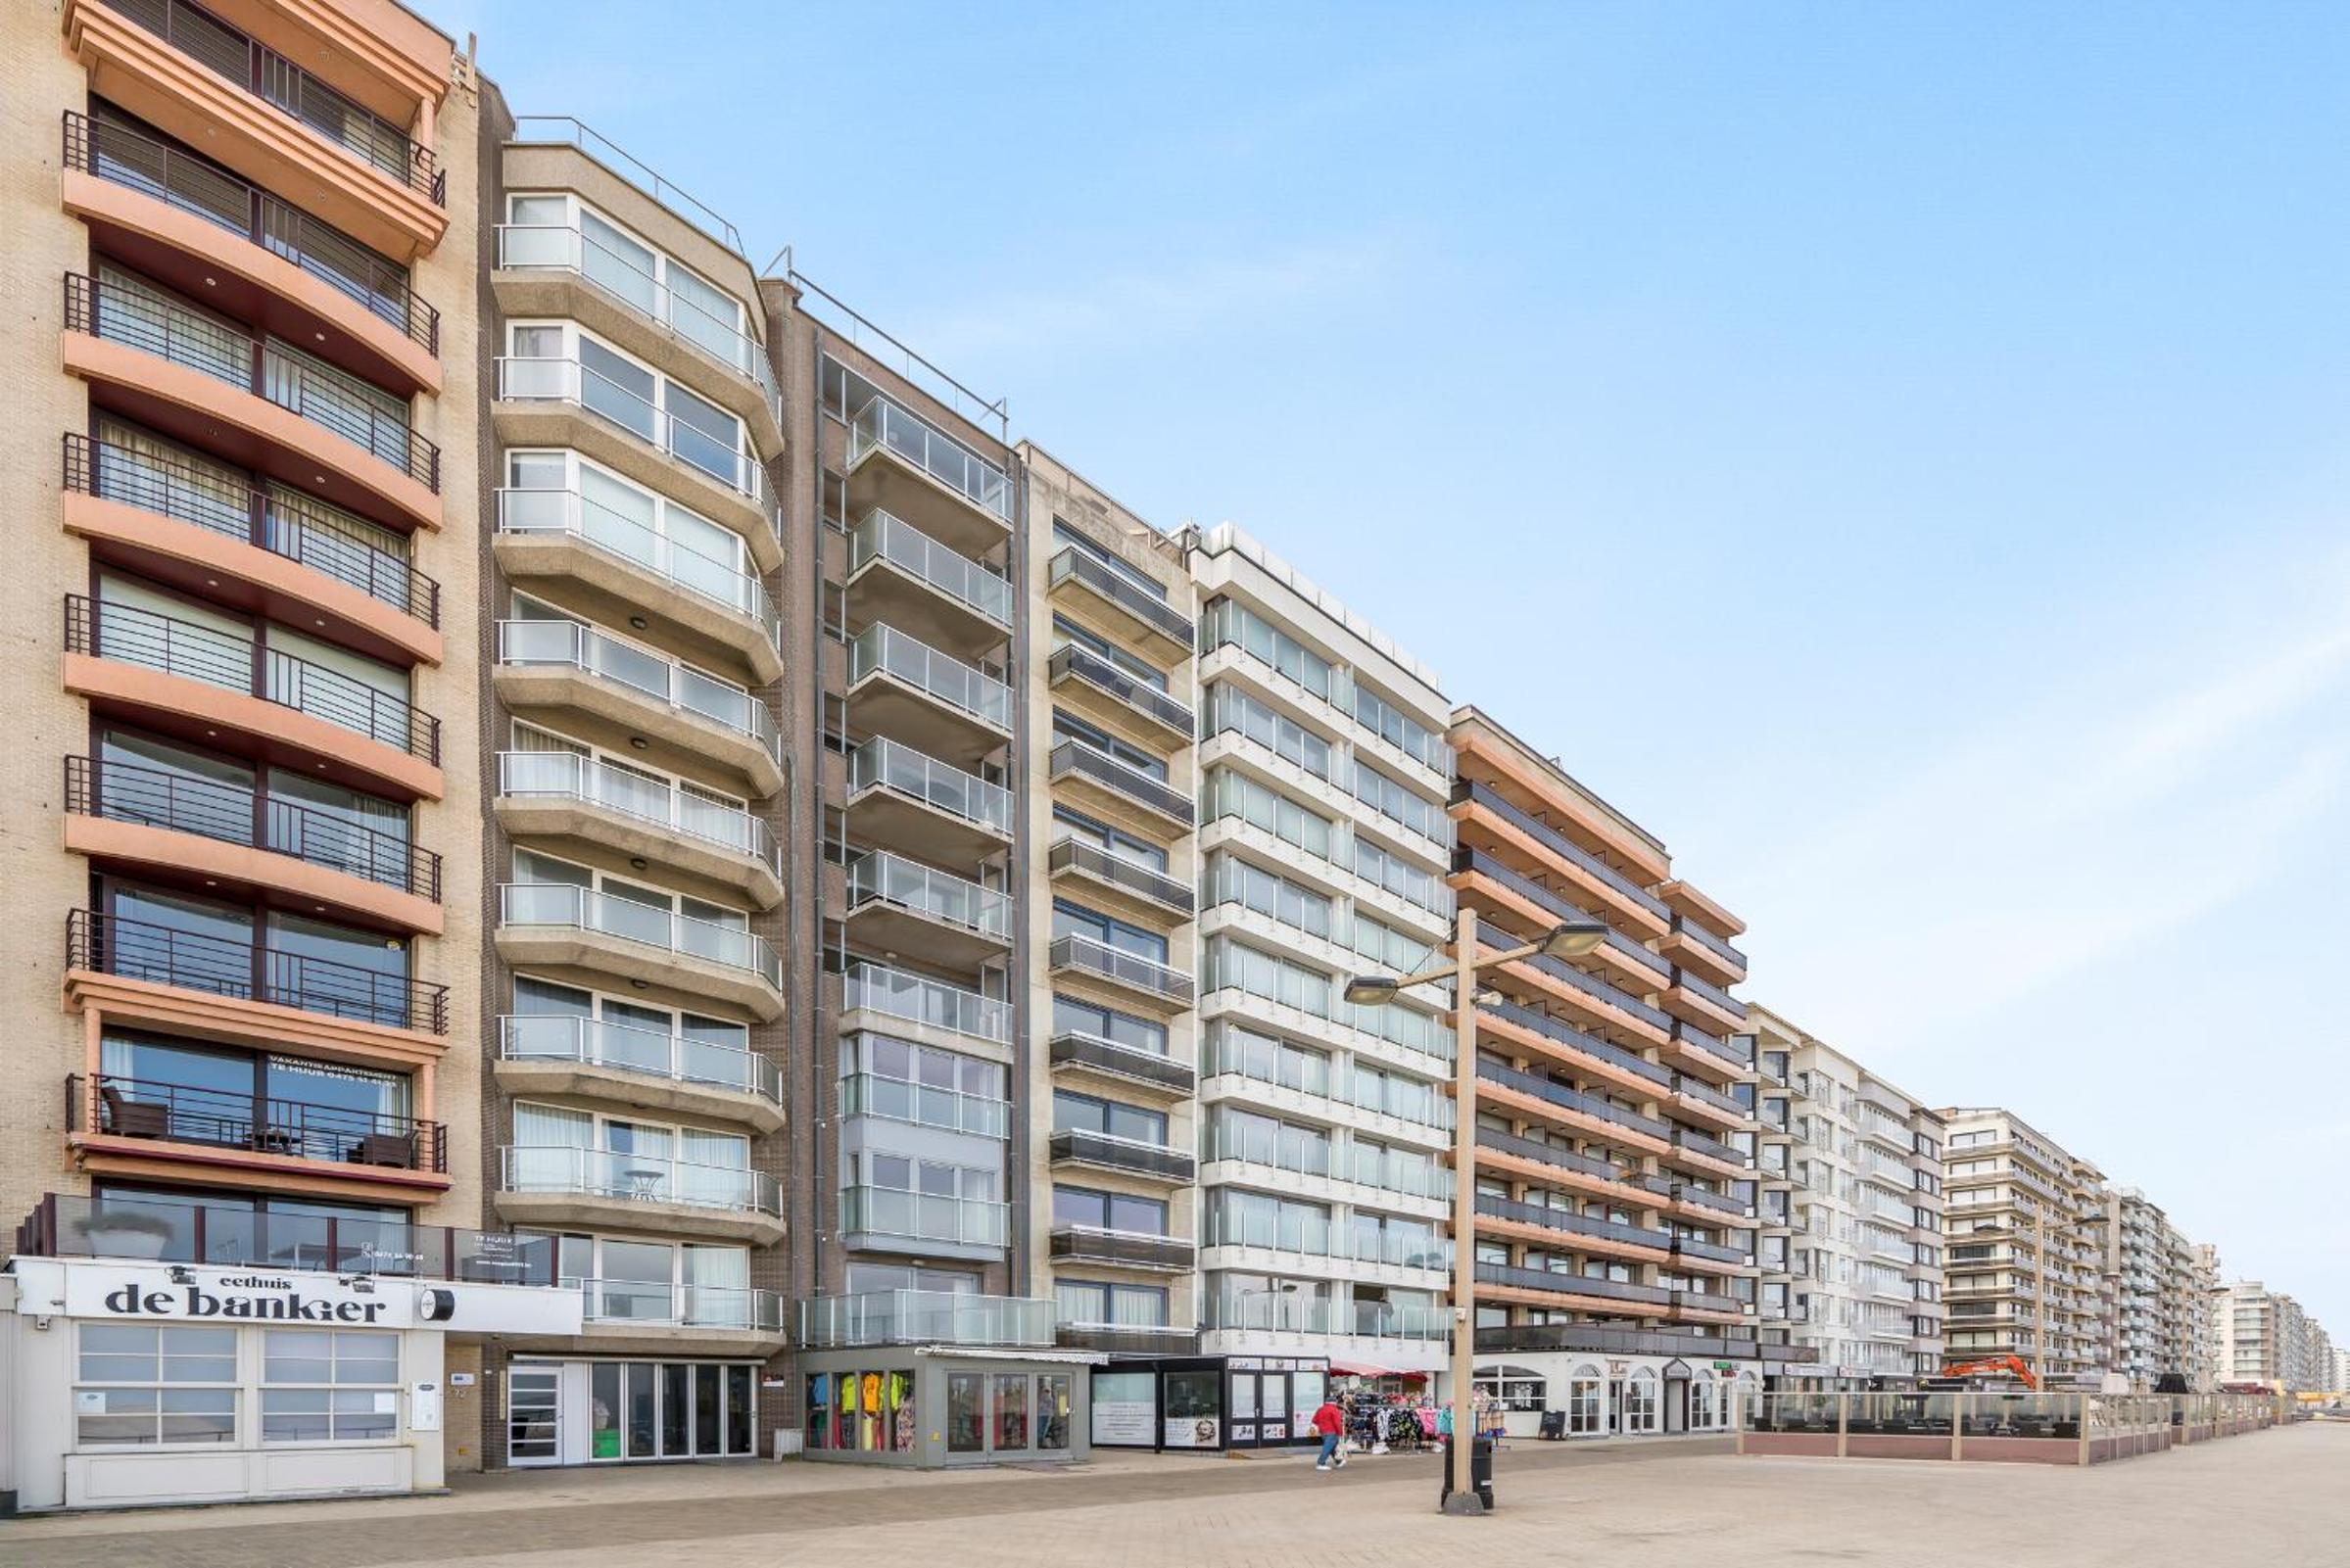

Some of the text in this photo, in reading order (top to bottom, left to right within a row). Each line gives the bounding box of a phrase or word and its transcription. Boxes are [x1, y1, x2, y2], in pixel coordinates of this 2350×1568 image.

[288, 1066, 325, 1077] HUUR
[219, 1276, 291, 1289] eethuis
[105, 1284, 386, 1322] de bankier
